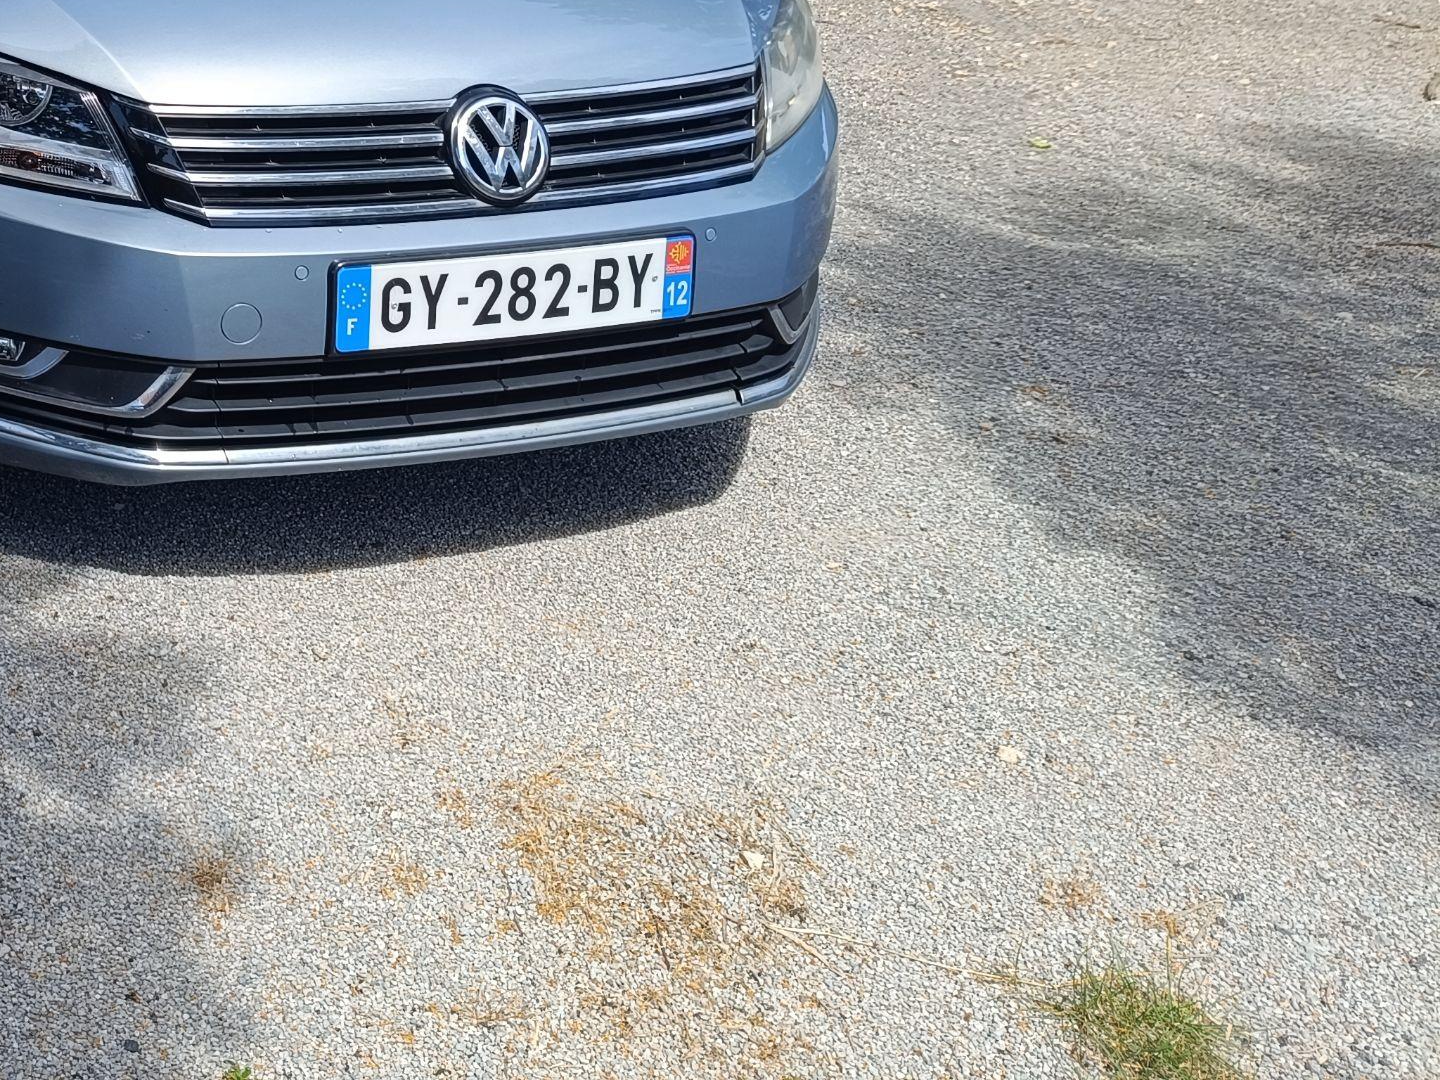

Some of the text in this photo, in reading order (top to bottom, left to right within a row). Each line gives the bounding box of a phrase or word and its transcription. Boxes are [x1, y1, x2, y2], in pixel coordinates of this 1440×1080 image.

[456, 100, 543, 194] VW
[381, 253, 654, 333] GY-282-BY
[666, 280, 689, 306] 12
[346, 318, 358, 336] F
